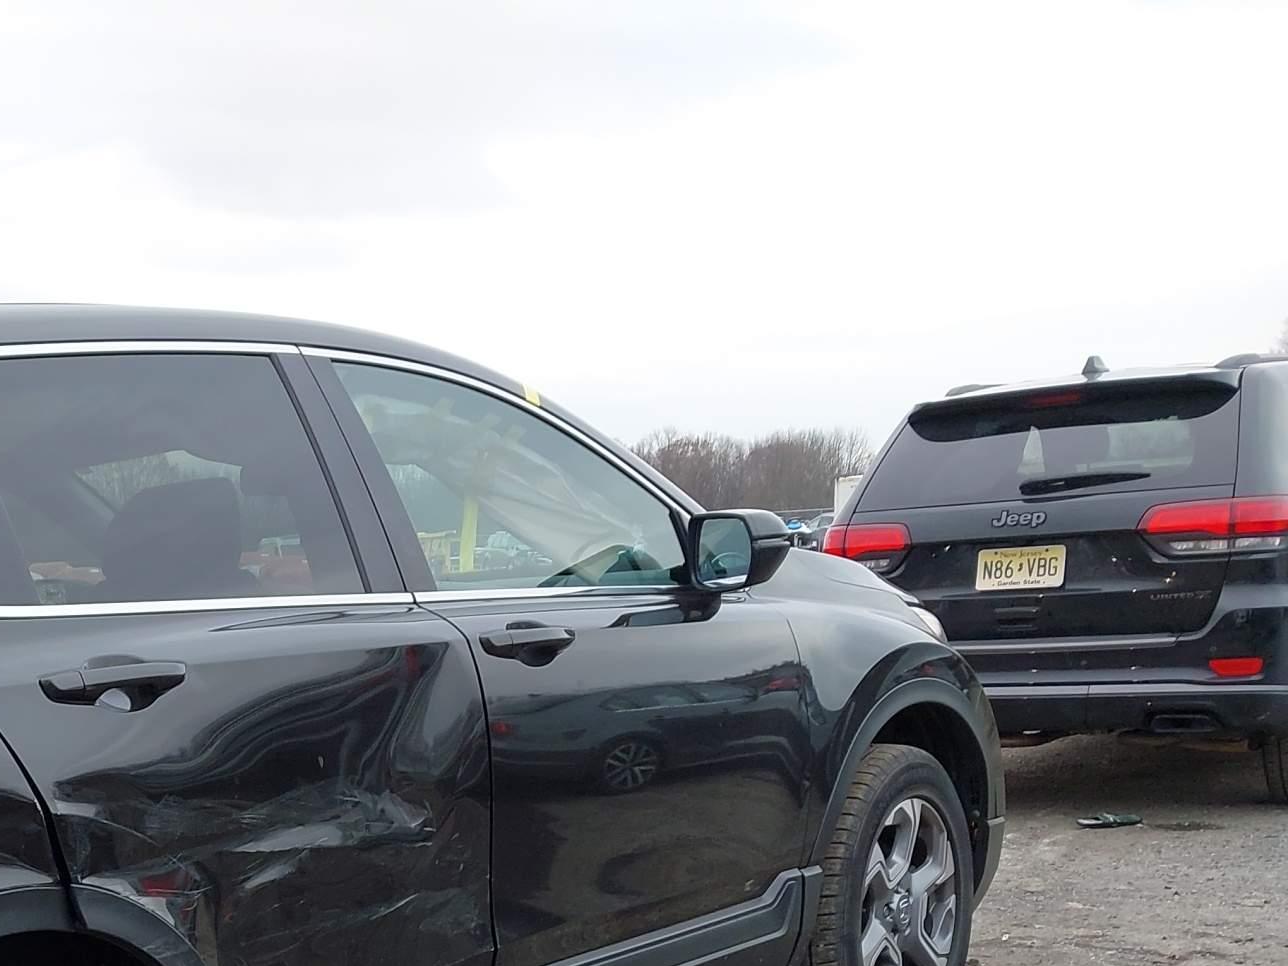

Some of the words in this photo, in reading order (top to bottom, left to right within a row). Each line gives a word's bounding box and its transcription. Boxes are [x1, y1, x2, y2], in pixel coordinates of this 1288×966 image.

[992, 510, 1047, 528] Jeep
[1019, 550, 1043, 559] Jersey
[983, 559, 1014, 580] N86
[1027, 557, 1058, 577] VBG
